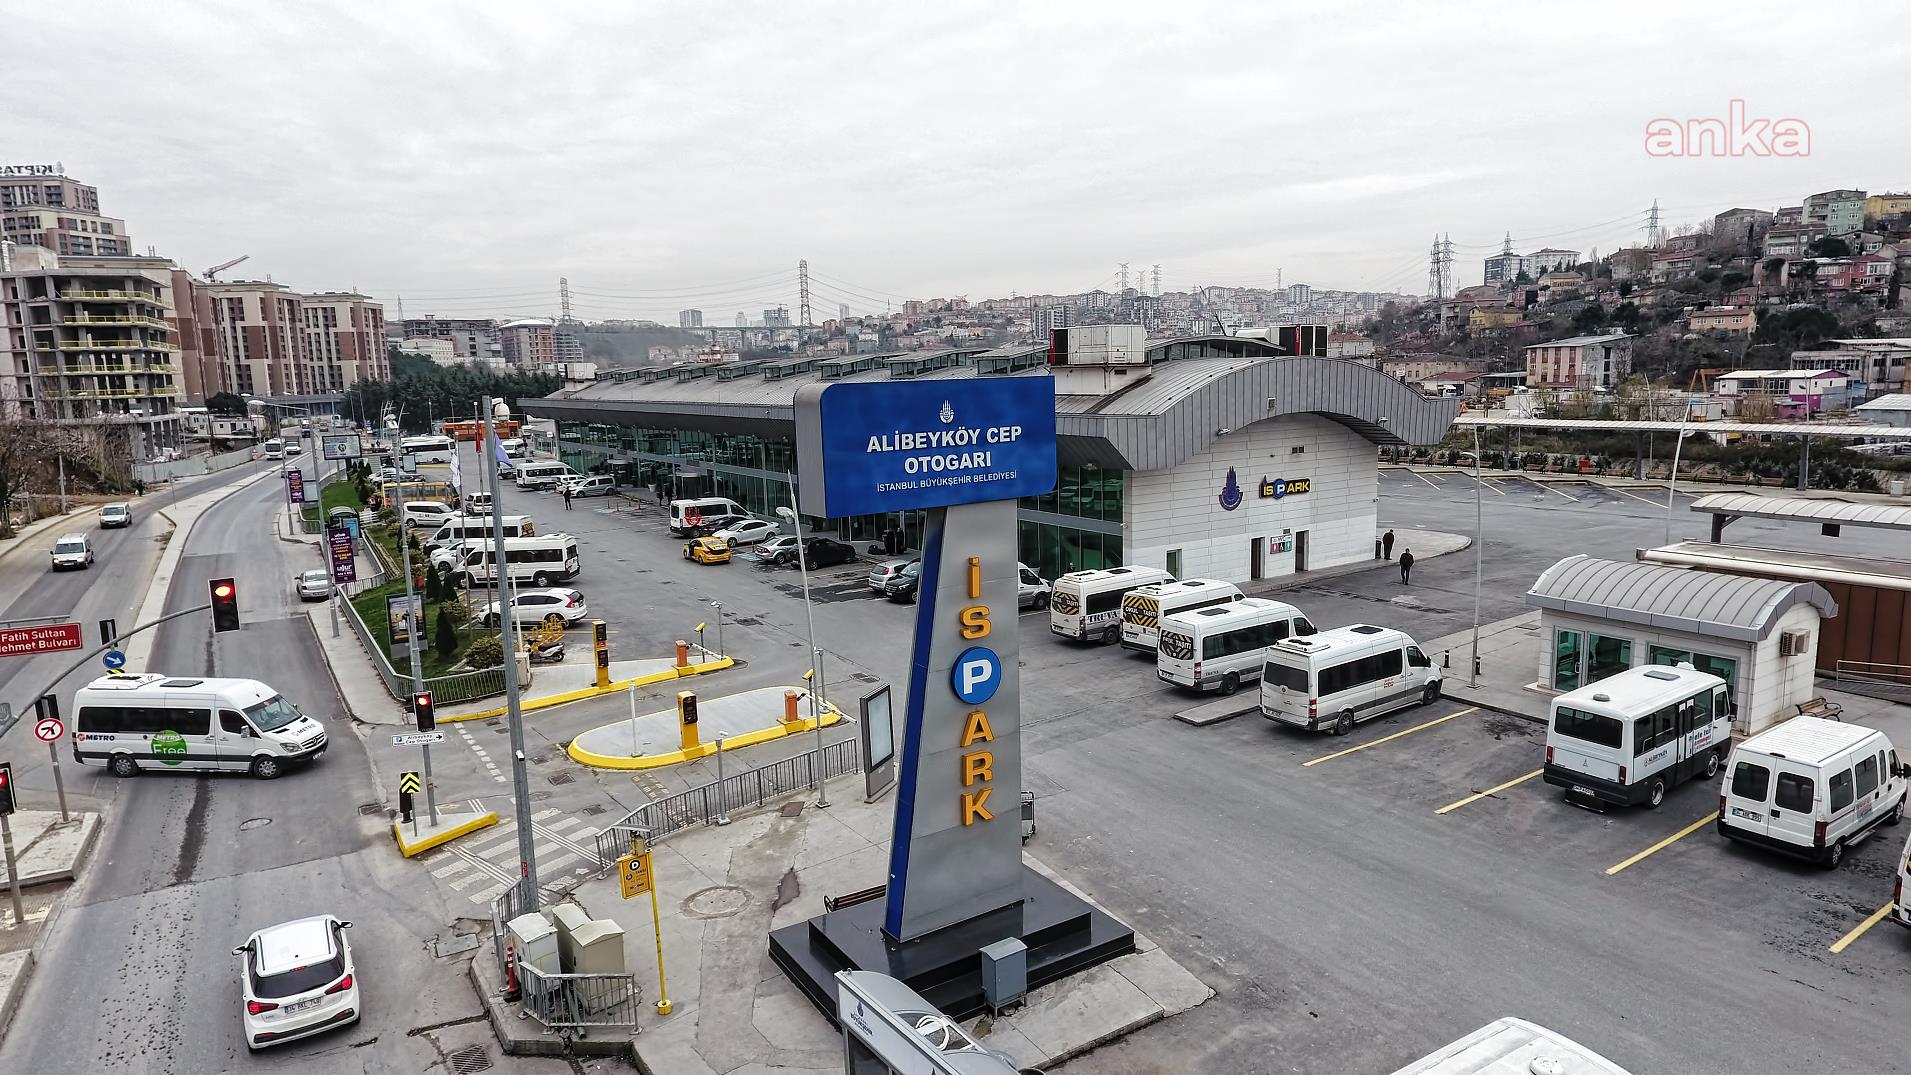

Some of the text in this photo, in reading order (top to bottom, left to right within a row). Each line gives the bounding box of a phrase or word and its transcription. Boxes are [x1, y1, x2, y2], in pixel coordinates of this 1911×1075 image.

[866, 425, 1022, 453] ALİBEYKÖY CEP
[904, 451, 992, 474] OTOGARI
[877, 470, 1017, 492] İSTANBUL BÜYÜKŞEHİR BELEDİYESİ
[1, 629, 66, 643] Fatih Sultan
[38, 638, 77, 649] Bulvarı
[959, 556, 995, 827] İSPARK
